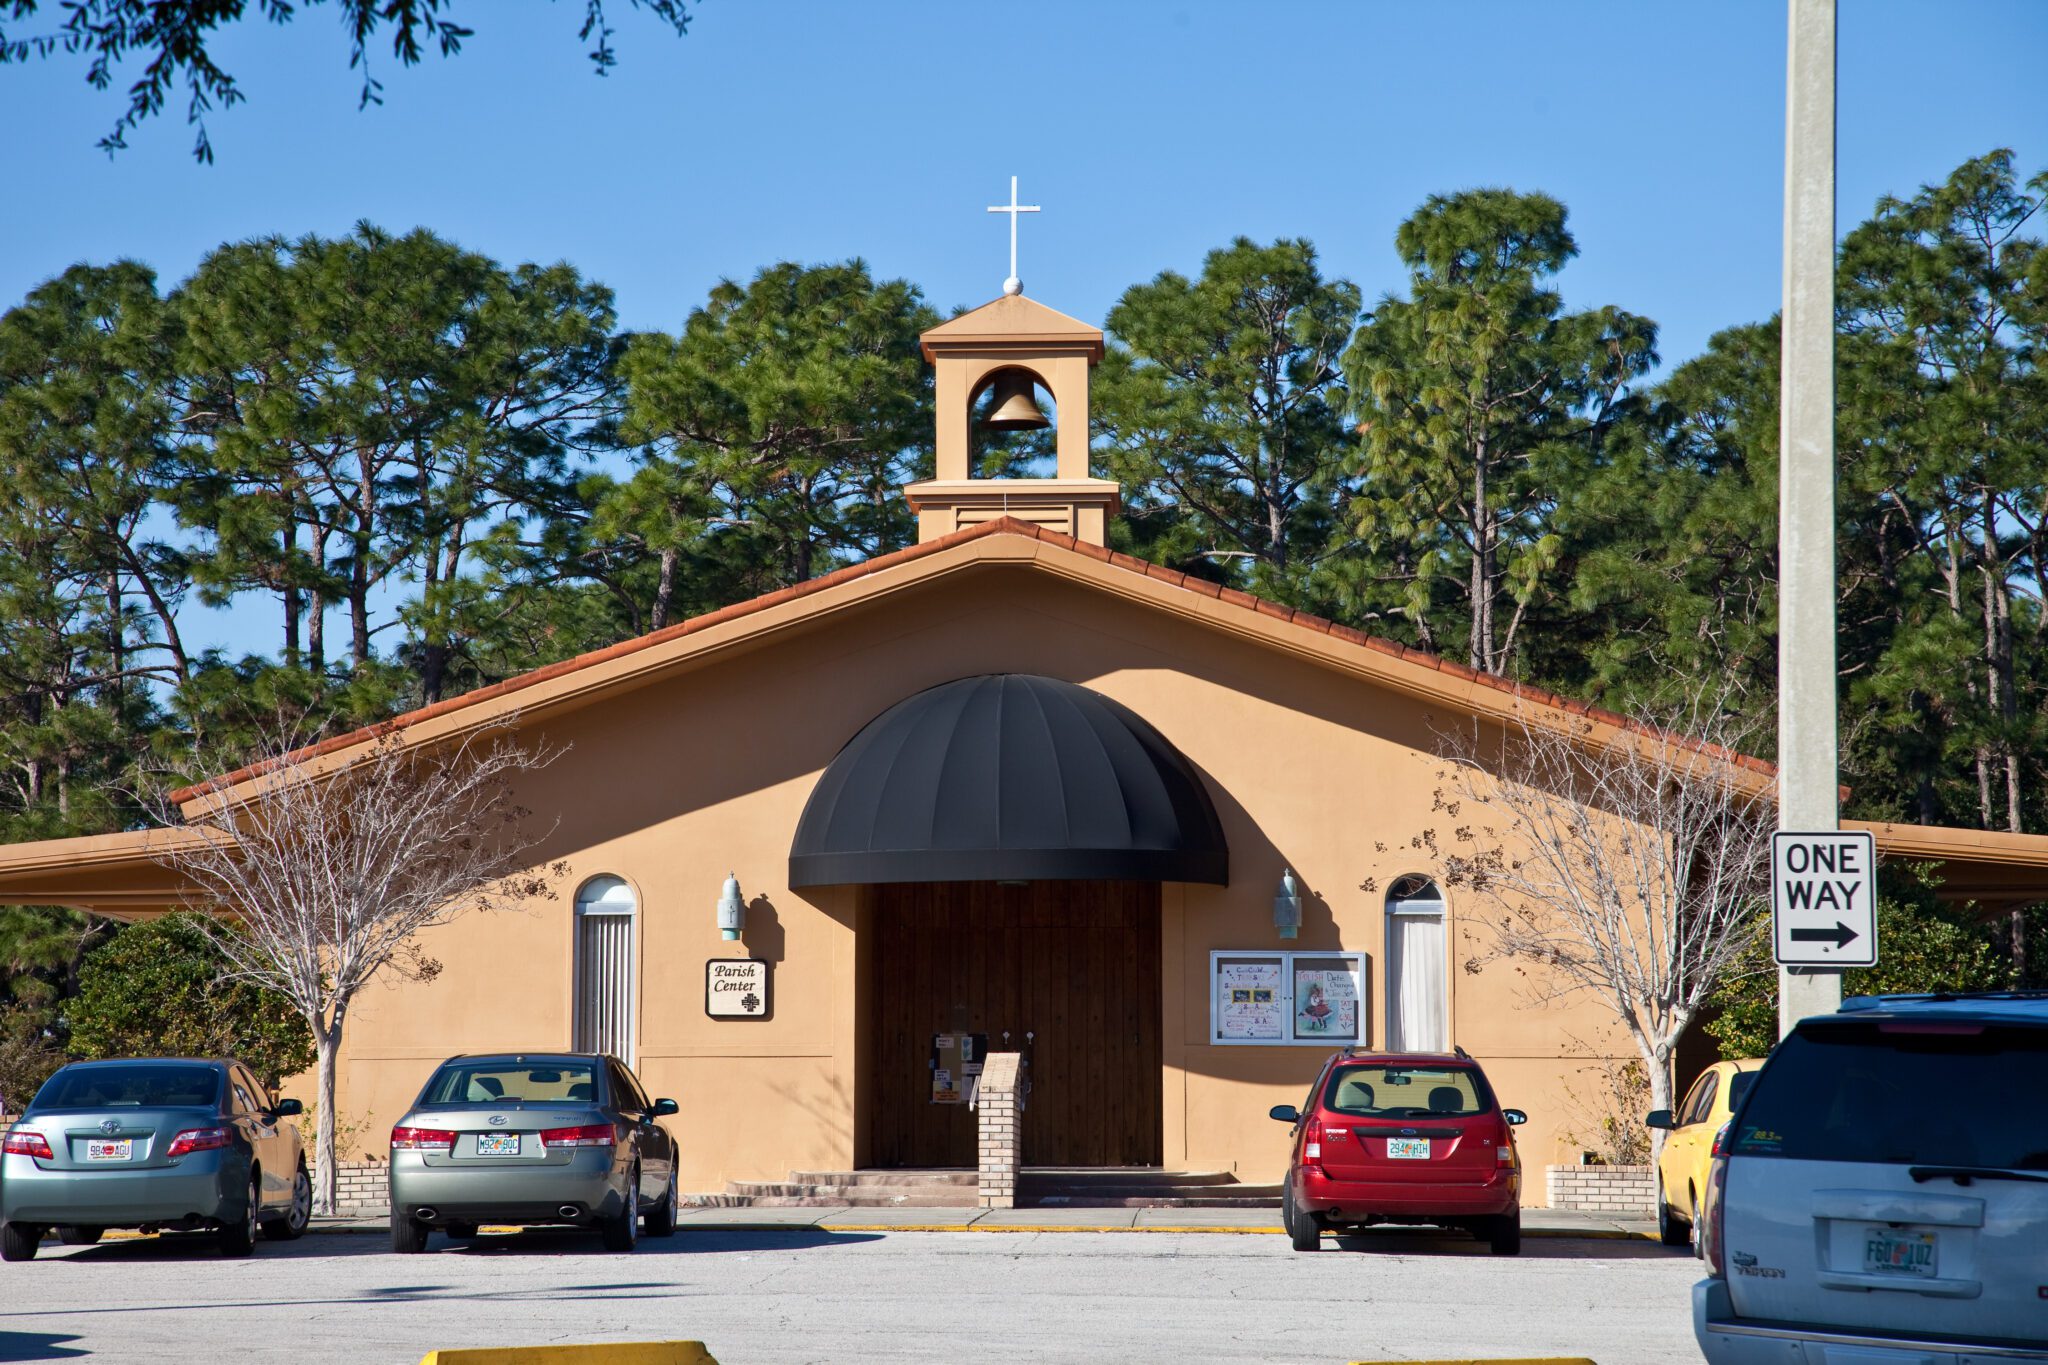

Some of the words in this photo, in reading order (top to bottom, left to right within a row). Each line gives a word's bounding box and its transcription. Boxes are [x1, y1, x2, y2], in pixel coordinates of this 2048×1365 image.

[1786, 843, 1860, 874] ONE
[1785, 880, 1862, 910] WAY
[714, 964, 756, 978] Parish
[714, 979, 756, 992] Center
[479, 1138, 495, 1150] M92
[1390, 1142, 1405, 1154] 294
[1413, 1143, 1428, 1154] HIH
[1866, 1240, 1892, 1263] F60
